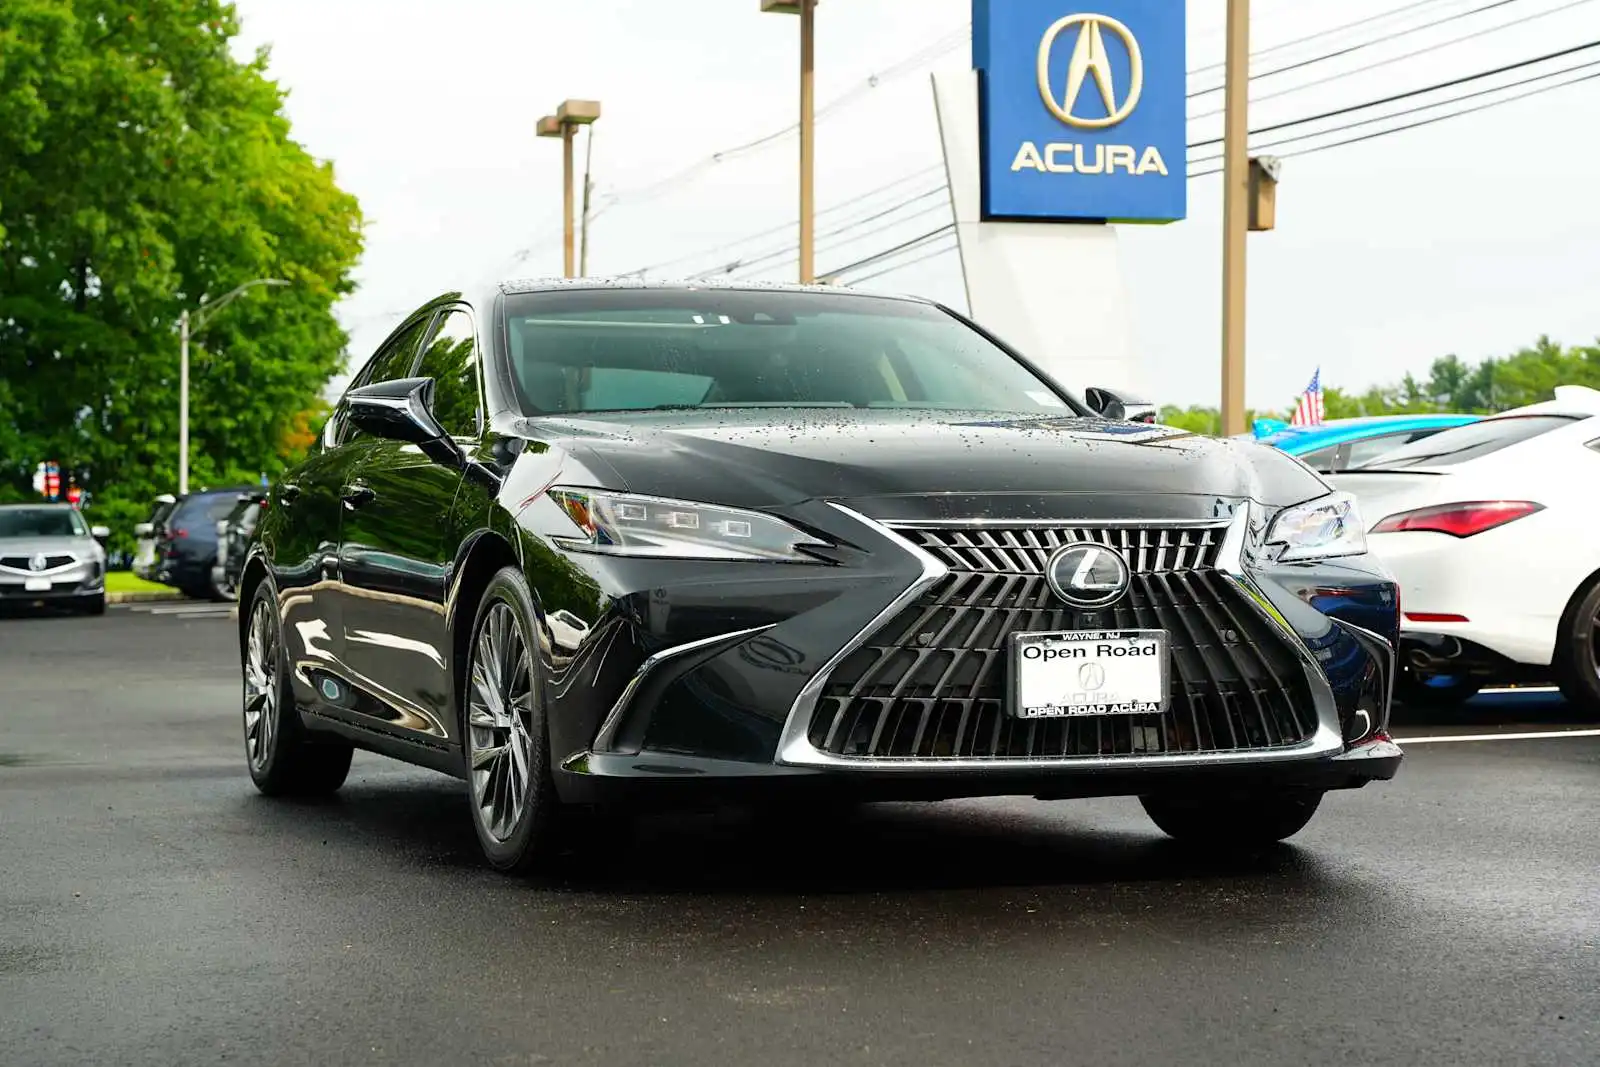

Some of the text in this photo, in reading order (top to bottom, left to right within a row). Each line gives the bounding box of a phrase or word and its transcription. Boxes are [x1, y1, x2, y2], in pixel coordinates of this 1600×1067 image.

[1011, 141, 1169, 176] ACURA
[1106, 631, 1121, 640] NJ
[1023, 643, 1157, 662] Open Road
[1028, 702, 1158, 716] OPEN ROAD ACURA
